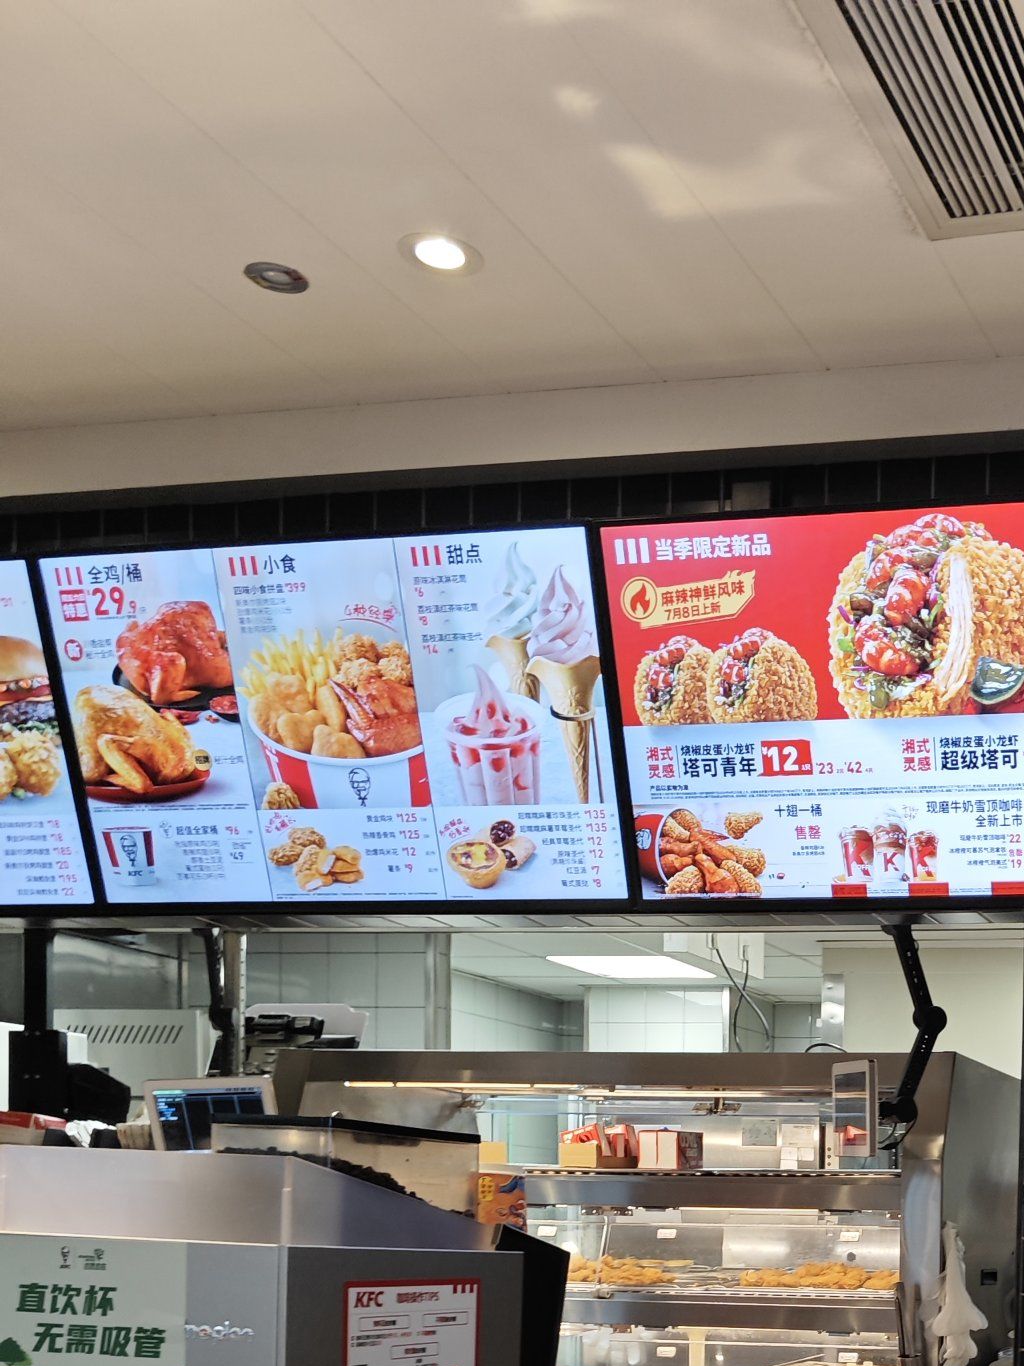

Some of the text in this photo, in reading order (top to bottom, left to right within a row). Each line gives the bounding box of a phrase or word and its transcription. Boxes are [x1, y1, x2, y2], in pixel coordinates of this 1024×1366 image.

[446, 544, 482, 565] 甜点
[655, 534, 771, 561] 当季限定新品
[263, 554, 296, 575] 小食
[88, 563, 142, 584] 全鸡/桶
[661, 580, 746, 606] 麻辣神鲜风味
[664, 602, 721, 620] 7月8日上新
[681, 743, 755, 756] 烧椒皮蛋小龙虾
[902, 738, 931, 754] 湘式
[939, 734, 1019, 748] 烧椒皮蛋小龙虾
[646, 746, 673, 762] 湘式
[940, 749, 1018, 771] 超级塔可
[648, 763, 675, 779] 灵感
[683, 757, 757, 778] 塔可青年
[903, 756, 932, 772] 灵感
[774, 804, 823, 818] 十翅一桶
[926, 799, 1023, 814] 现磨牛奶雪顶咖啡
[975, 815, 1023, 828] 全新上市
[795, 825, 821, 840] 售罄
[16, 1283, 117, 1317] 直饮杯
[354, 1291, 384, 1308] KFC
[32, 1322, 166, 1359] 无需吸管
